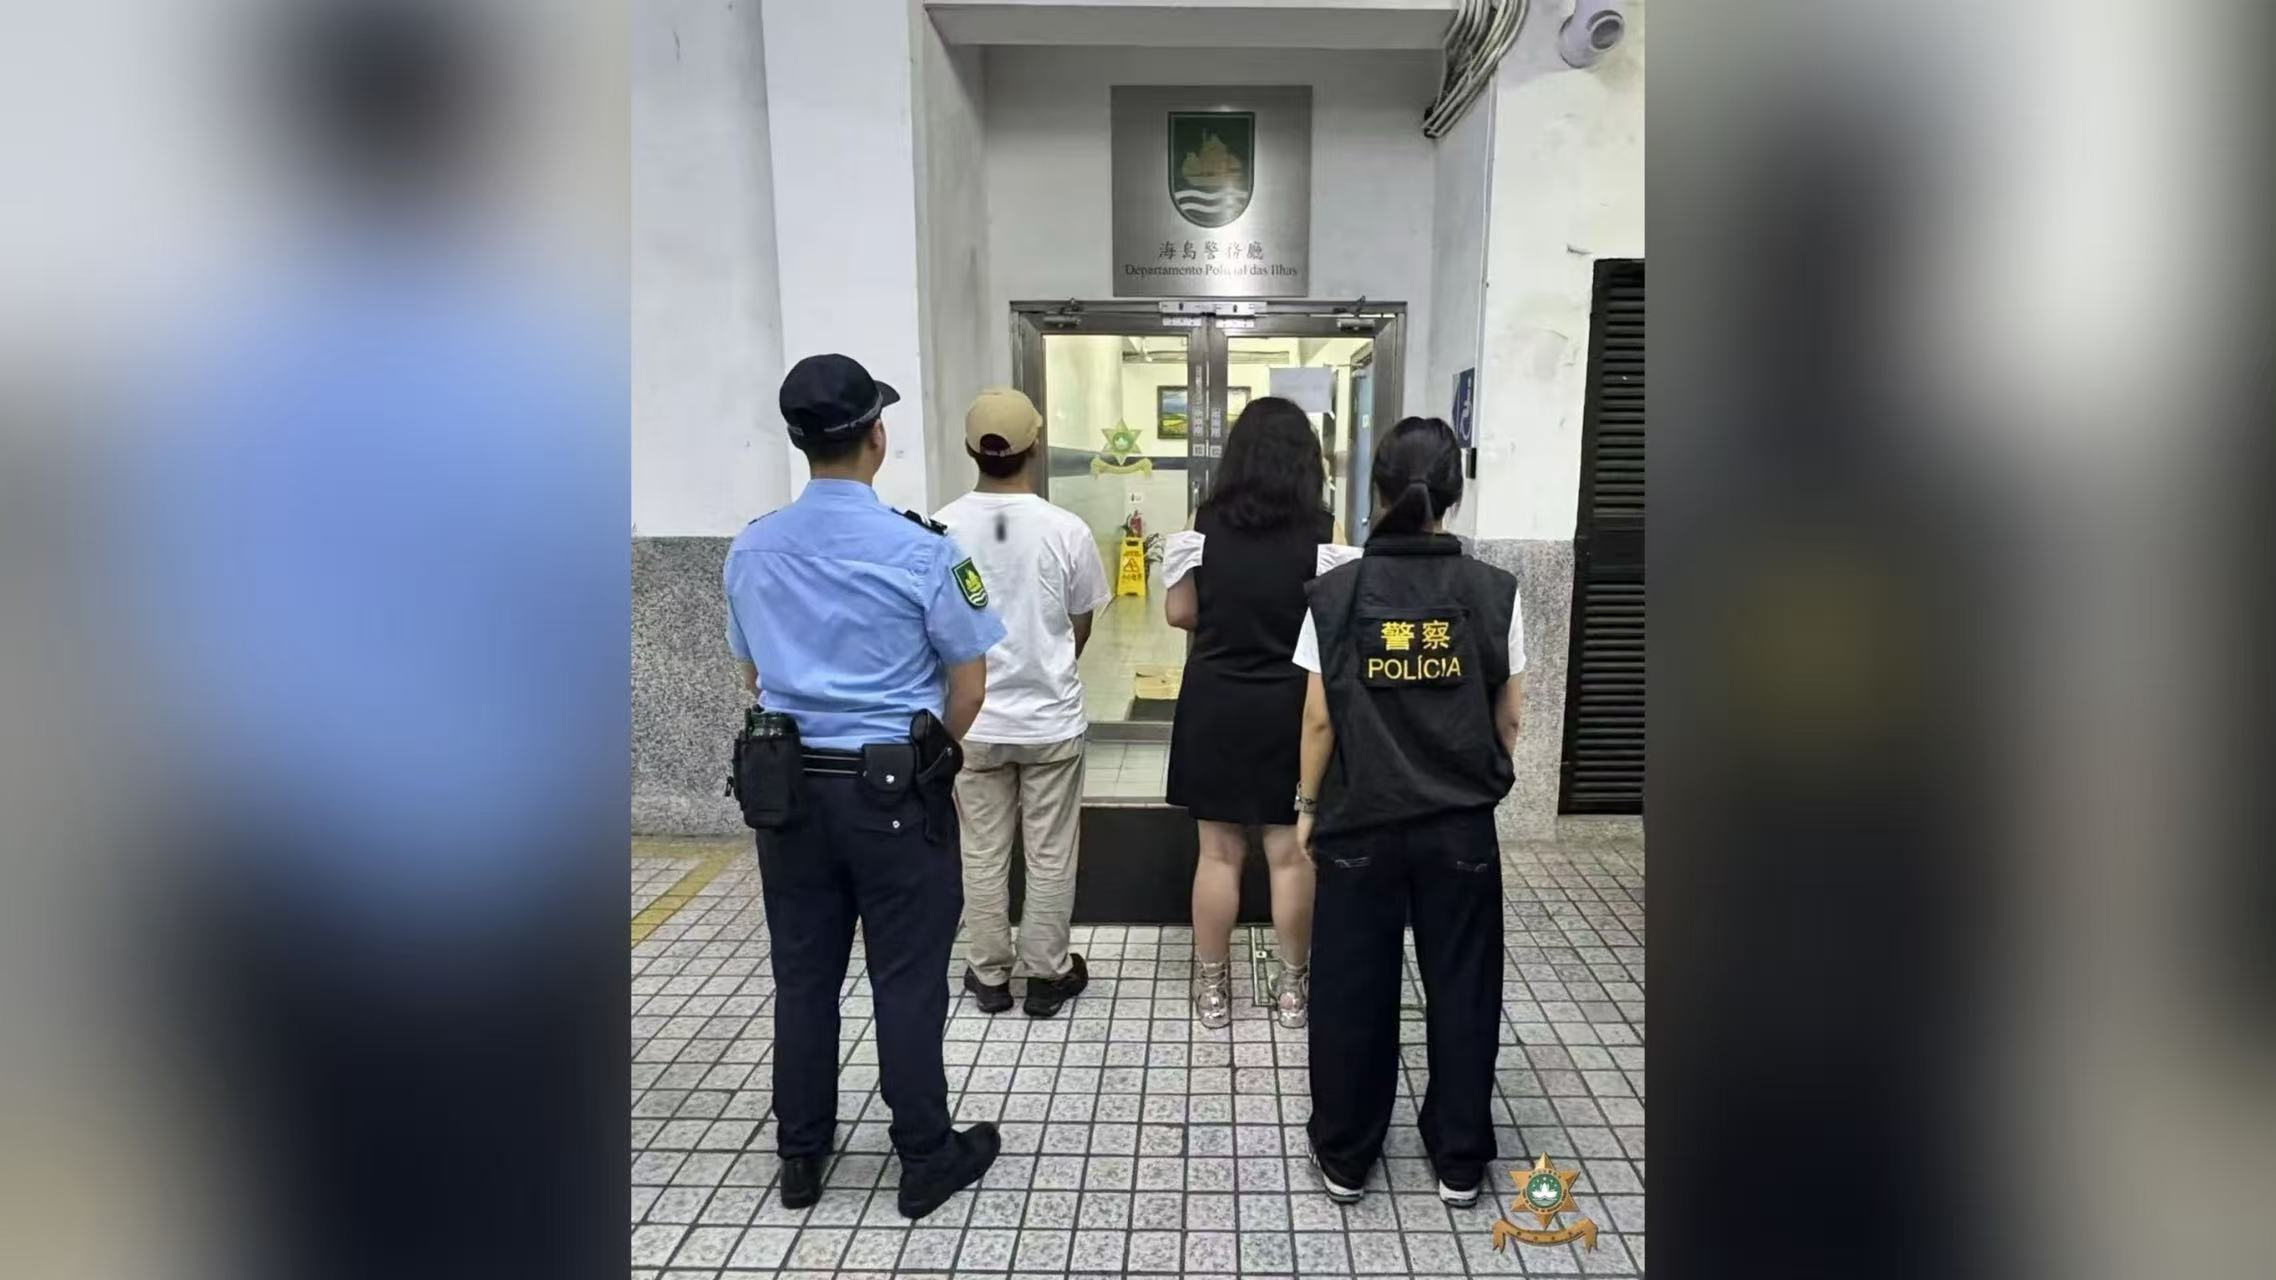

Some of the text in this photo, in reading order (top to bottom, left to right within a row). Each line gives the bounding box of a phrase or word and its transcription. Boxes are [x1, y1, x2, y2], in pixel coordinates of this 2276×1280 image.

[1125, 264, 1203, 277] Departamento
[1249, 264, 1268, 276] das
[1271, 263, 1298, 276] Ilhas
[1380, 620, 1451, 651] 警察
[1368, 655, 1461, 680] POLÍCIA
